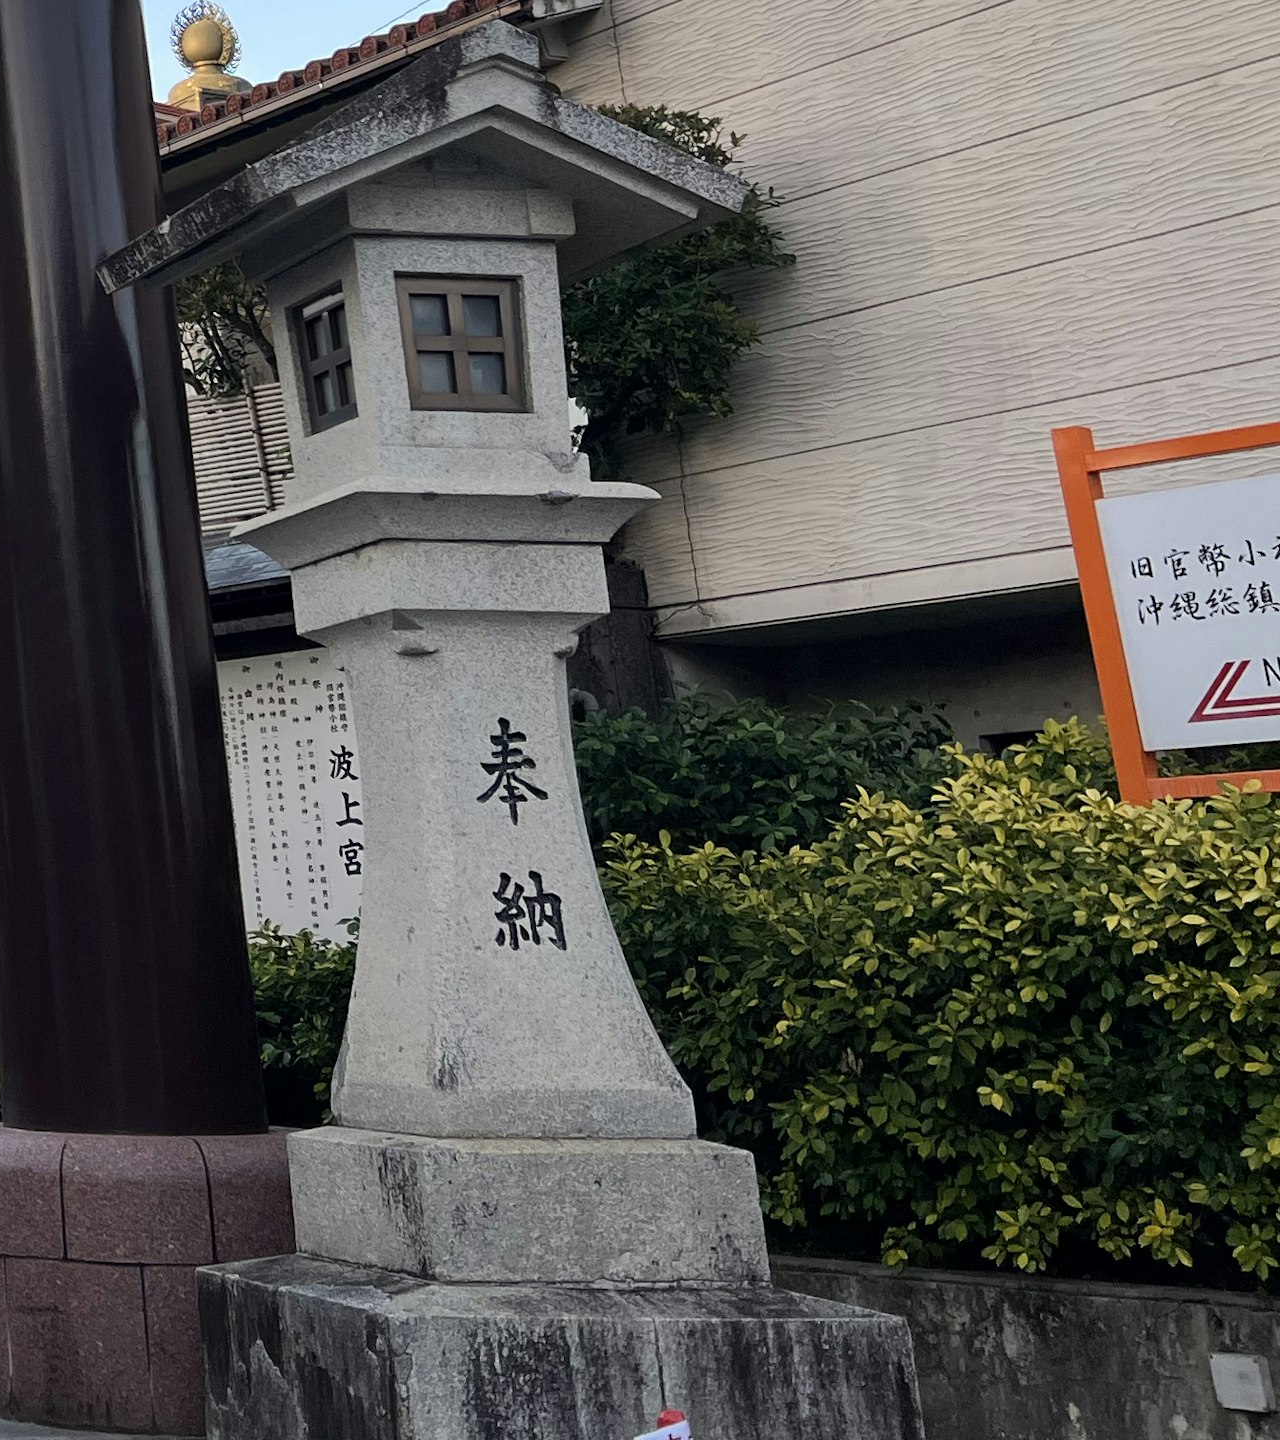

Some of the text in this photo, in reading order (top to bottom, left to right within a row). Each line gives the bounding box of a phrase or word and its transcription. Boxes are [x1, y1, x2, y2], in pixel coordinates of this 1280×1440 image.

[329, 745, 364, 876] 波上宮
[477, 717, 567, 952] 奉納
